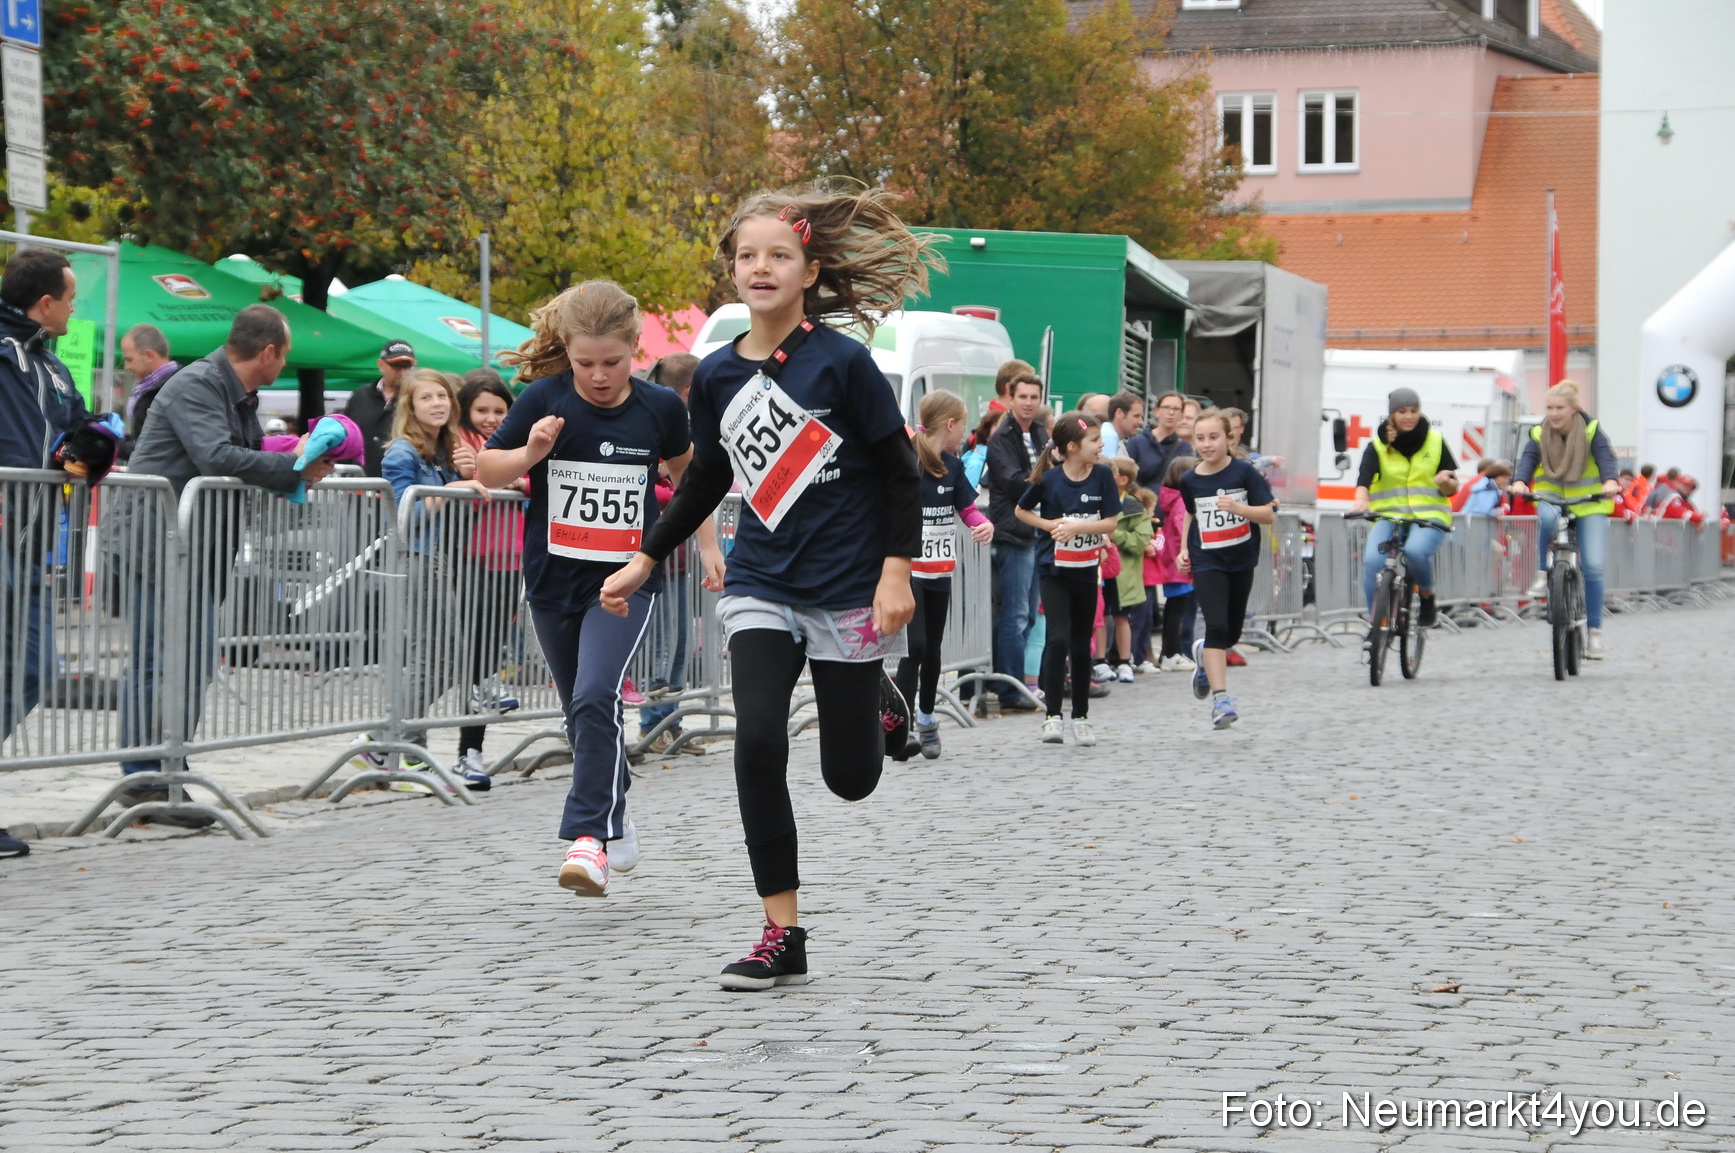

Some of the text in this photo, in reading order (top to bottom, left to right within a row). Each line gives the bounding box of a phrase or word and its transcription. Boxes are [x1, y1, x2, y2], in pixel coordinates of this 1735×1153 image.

[727, 390, 764, 435] Neumarkt
[551, 469, 635, 484] PARTL Neumarkt
[560, 484, 640, 525] 7555
